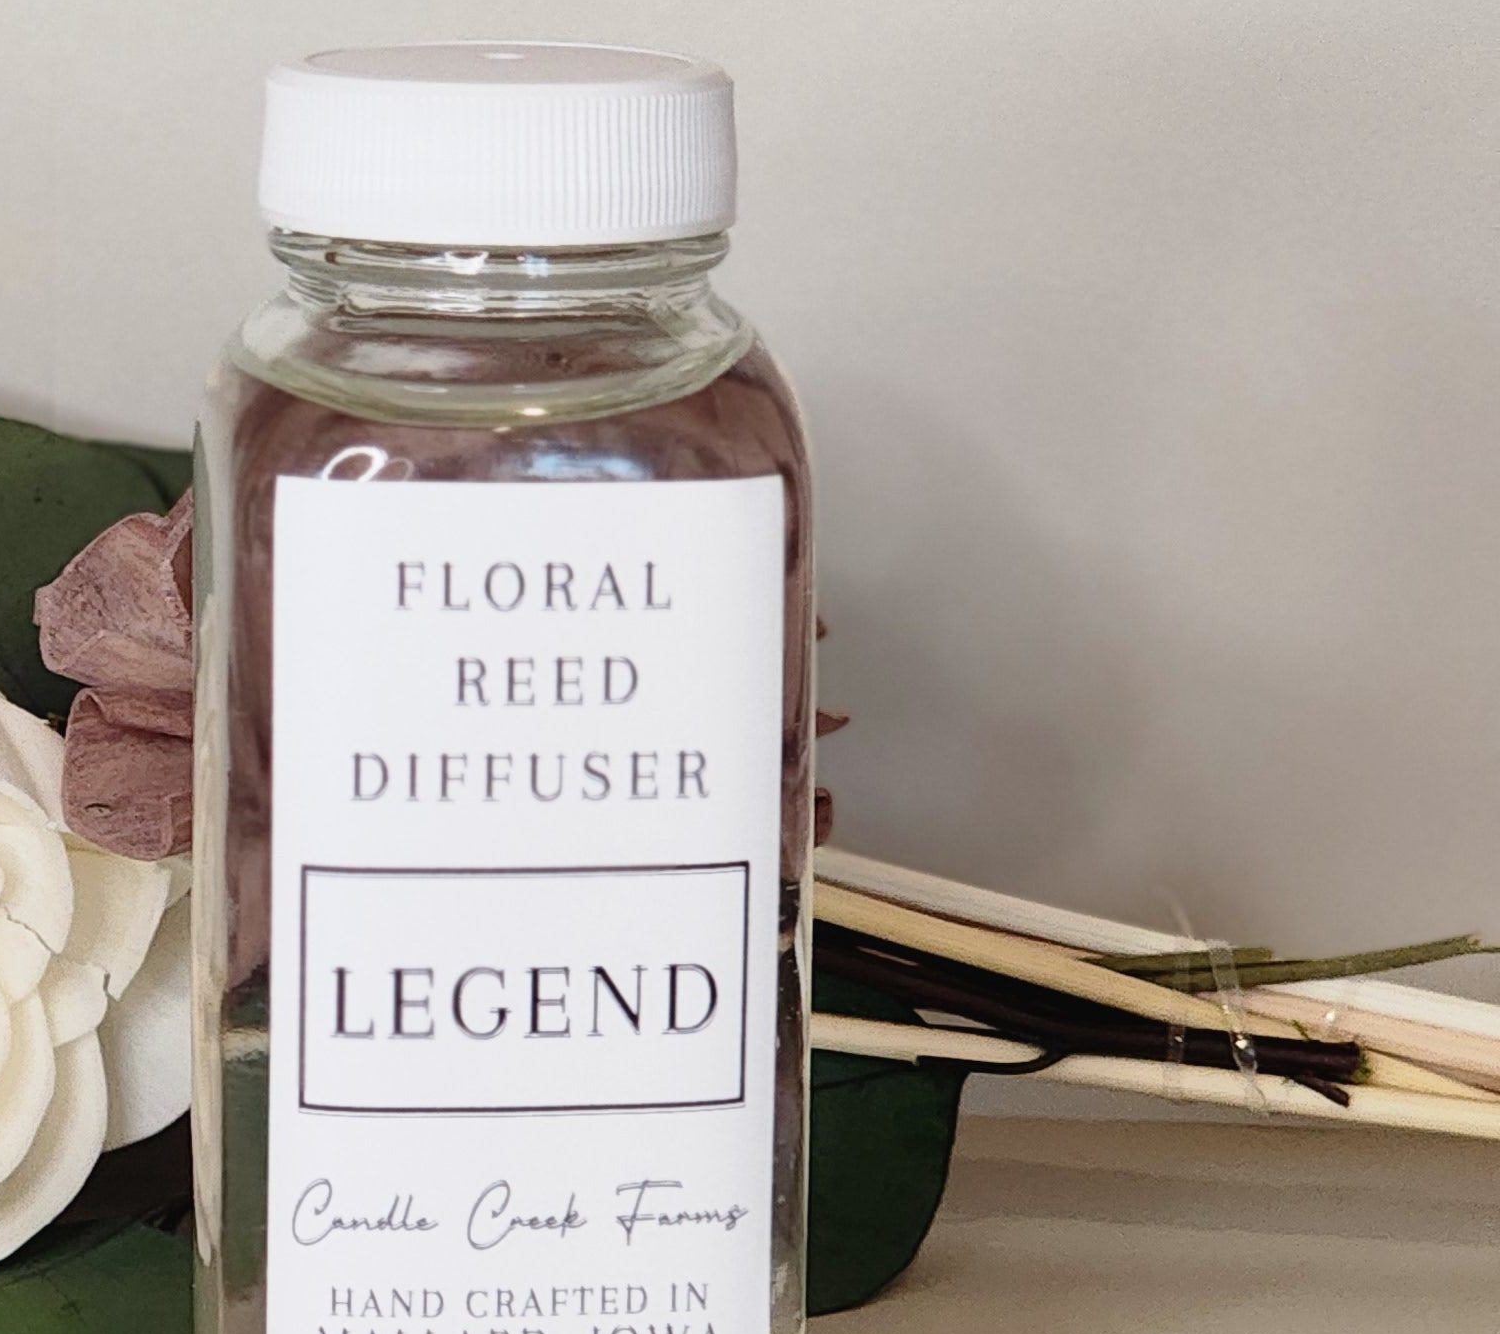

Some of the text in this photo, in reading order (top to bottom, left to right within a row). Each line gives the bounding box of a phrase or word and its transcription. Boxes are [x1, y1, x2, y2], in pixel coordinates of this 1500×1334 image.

[395, 560, 672, 613] FLORAL
[455, 655, 640, 708] REED
[351, 749, 710, 803] DIFFUSER
[330, 962, 720, 1041] LEGEND
[291, 1177, 751, 1251] Candle Creek Farms
[330, 1281, 709, 1319] HAND CRAFTED IN
